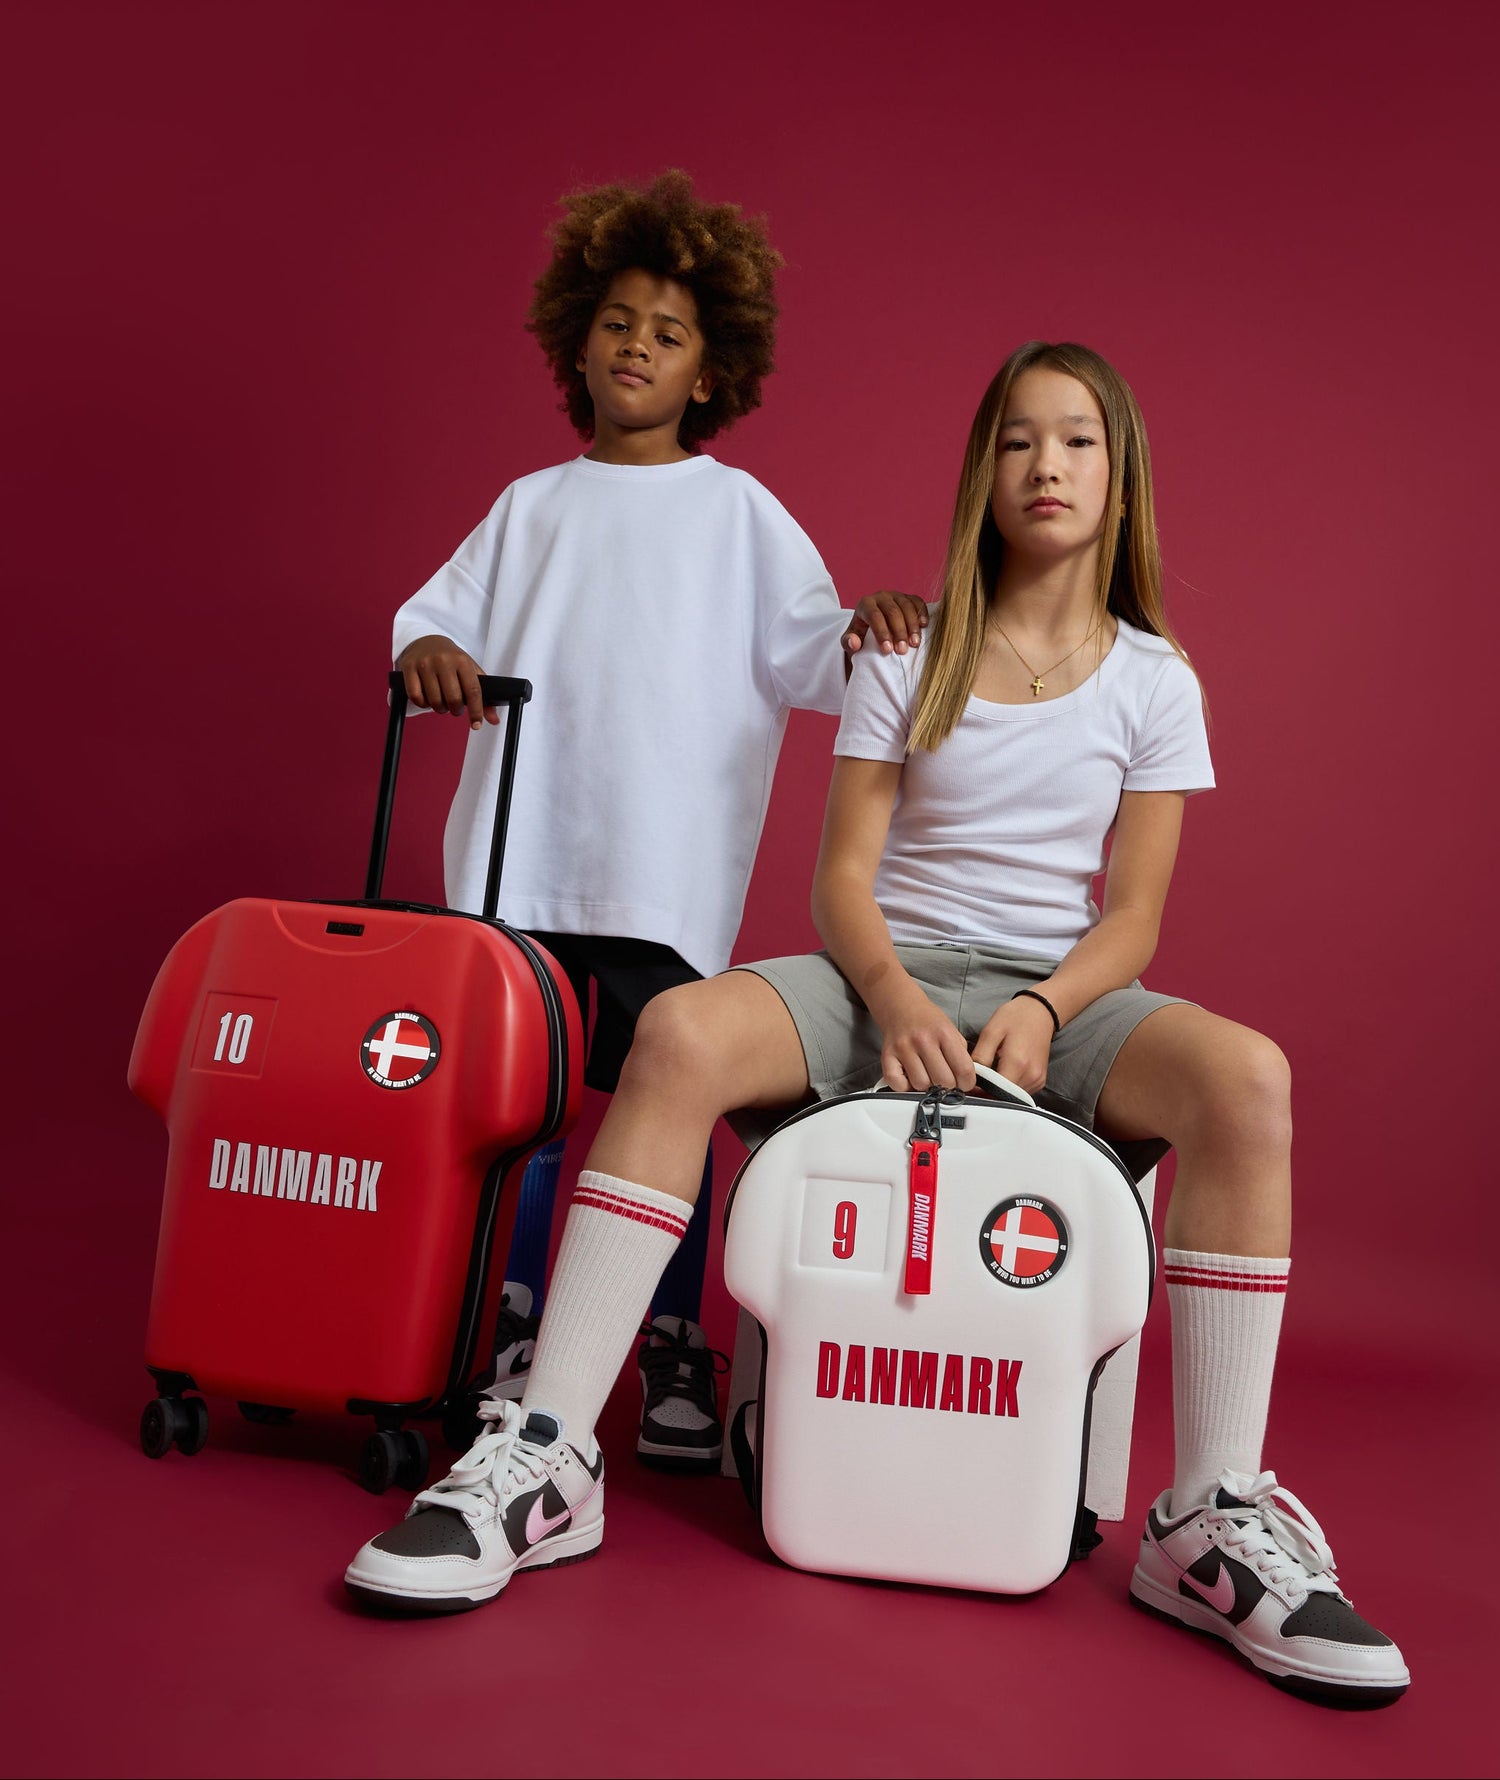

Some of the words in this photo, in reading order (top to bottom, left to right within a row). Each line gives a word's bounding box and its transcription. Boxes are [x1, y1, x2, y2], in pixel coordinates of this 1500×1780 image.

[212, 1010, 254, 1065] 10
[394, 1012, 420, 1023] DANMARK
[208, 1137, 384, 1213] DANMARK
[832, 1200, 858, 1260] 9
[911, 1192, 930, 1262] DANMARK
[1015, 1198, 1044, 1210] DANMARK
[990, 1260, 999, 1271] BE
[996, 1267, 1009, 1280] WHO
[1008, 1274, 1020, 1285] YOU
[1020, 1276, 1037, 1285] WANT
[1037, 1273, 1045, 1282] TO
[1043, 1268, 1053, 1278] BE
[816, 1340, 1024, 1418] DANMARK
